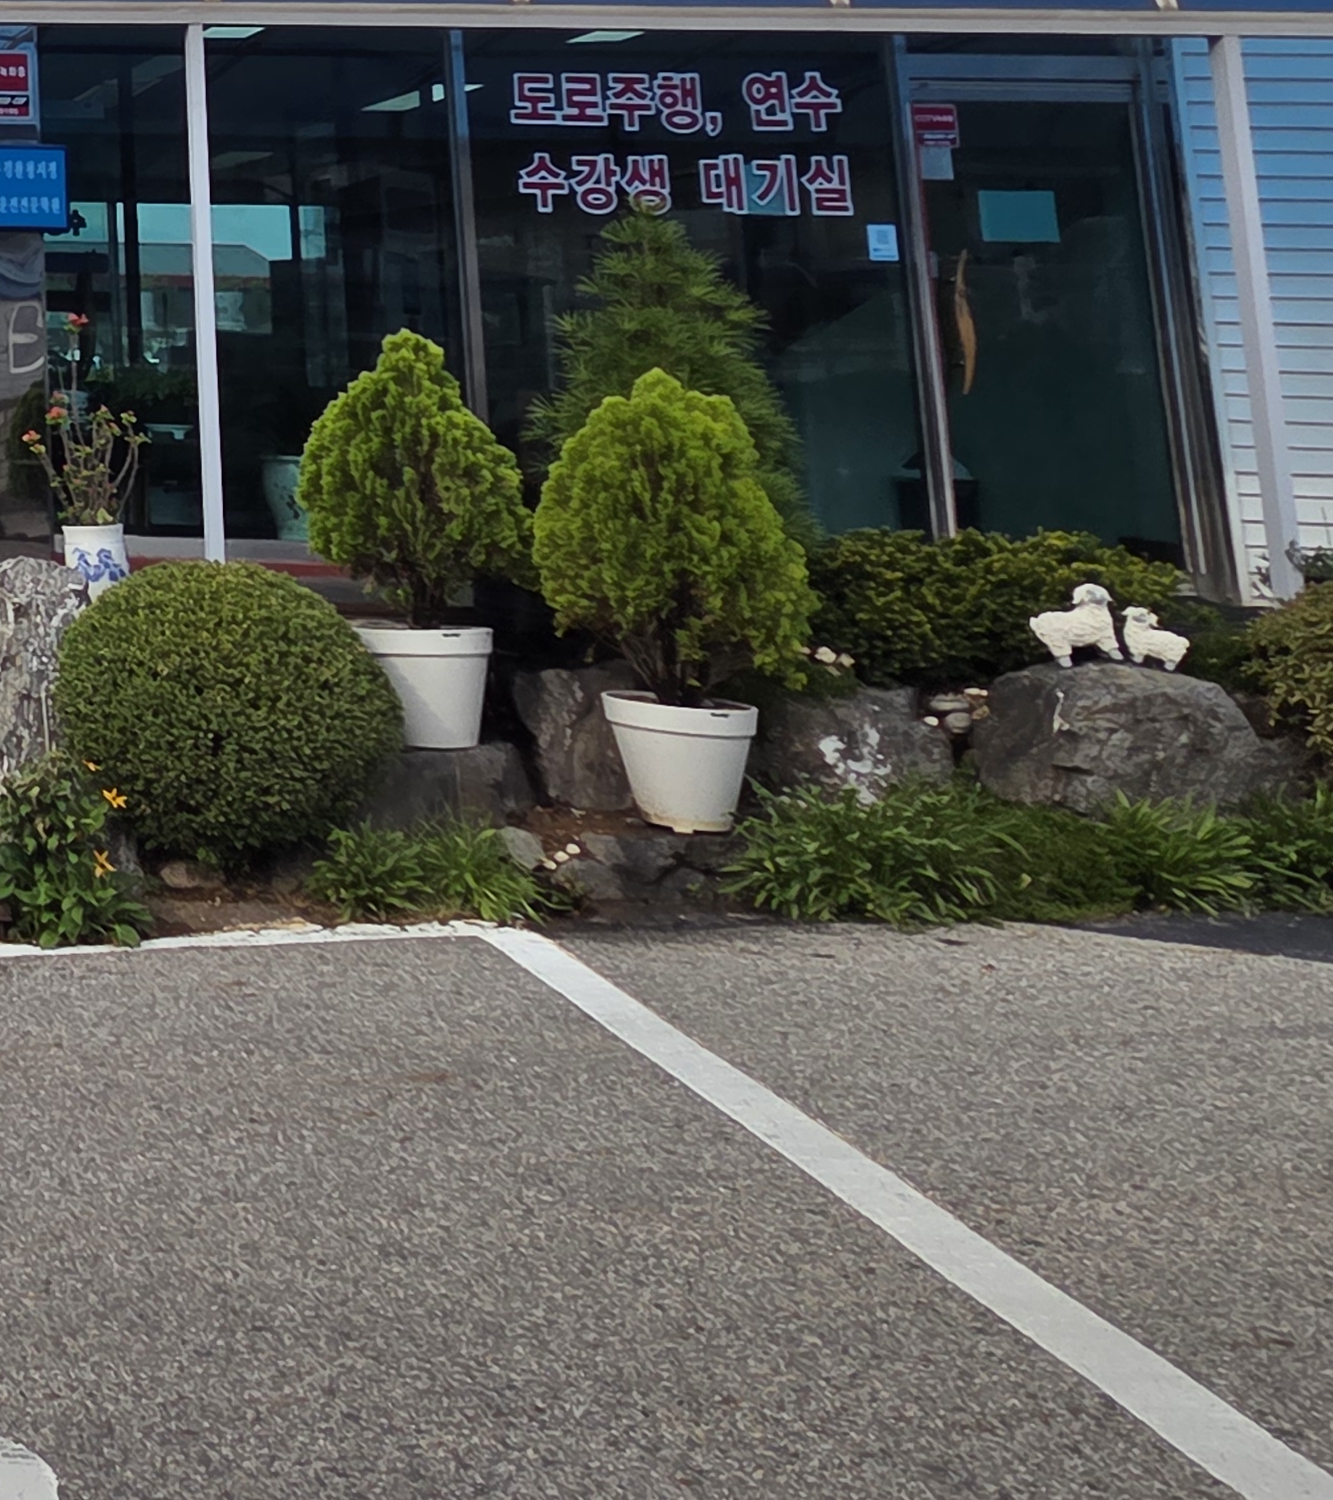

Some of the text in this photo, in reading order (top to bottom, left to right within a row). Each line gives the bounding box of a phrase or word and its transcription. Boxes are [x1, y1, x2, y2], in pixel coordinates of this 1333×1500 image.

[510, 71, 842, 136] 도로주행, 연수
[519, 152, 854, 216] 수강생 대기실
